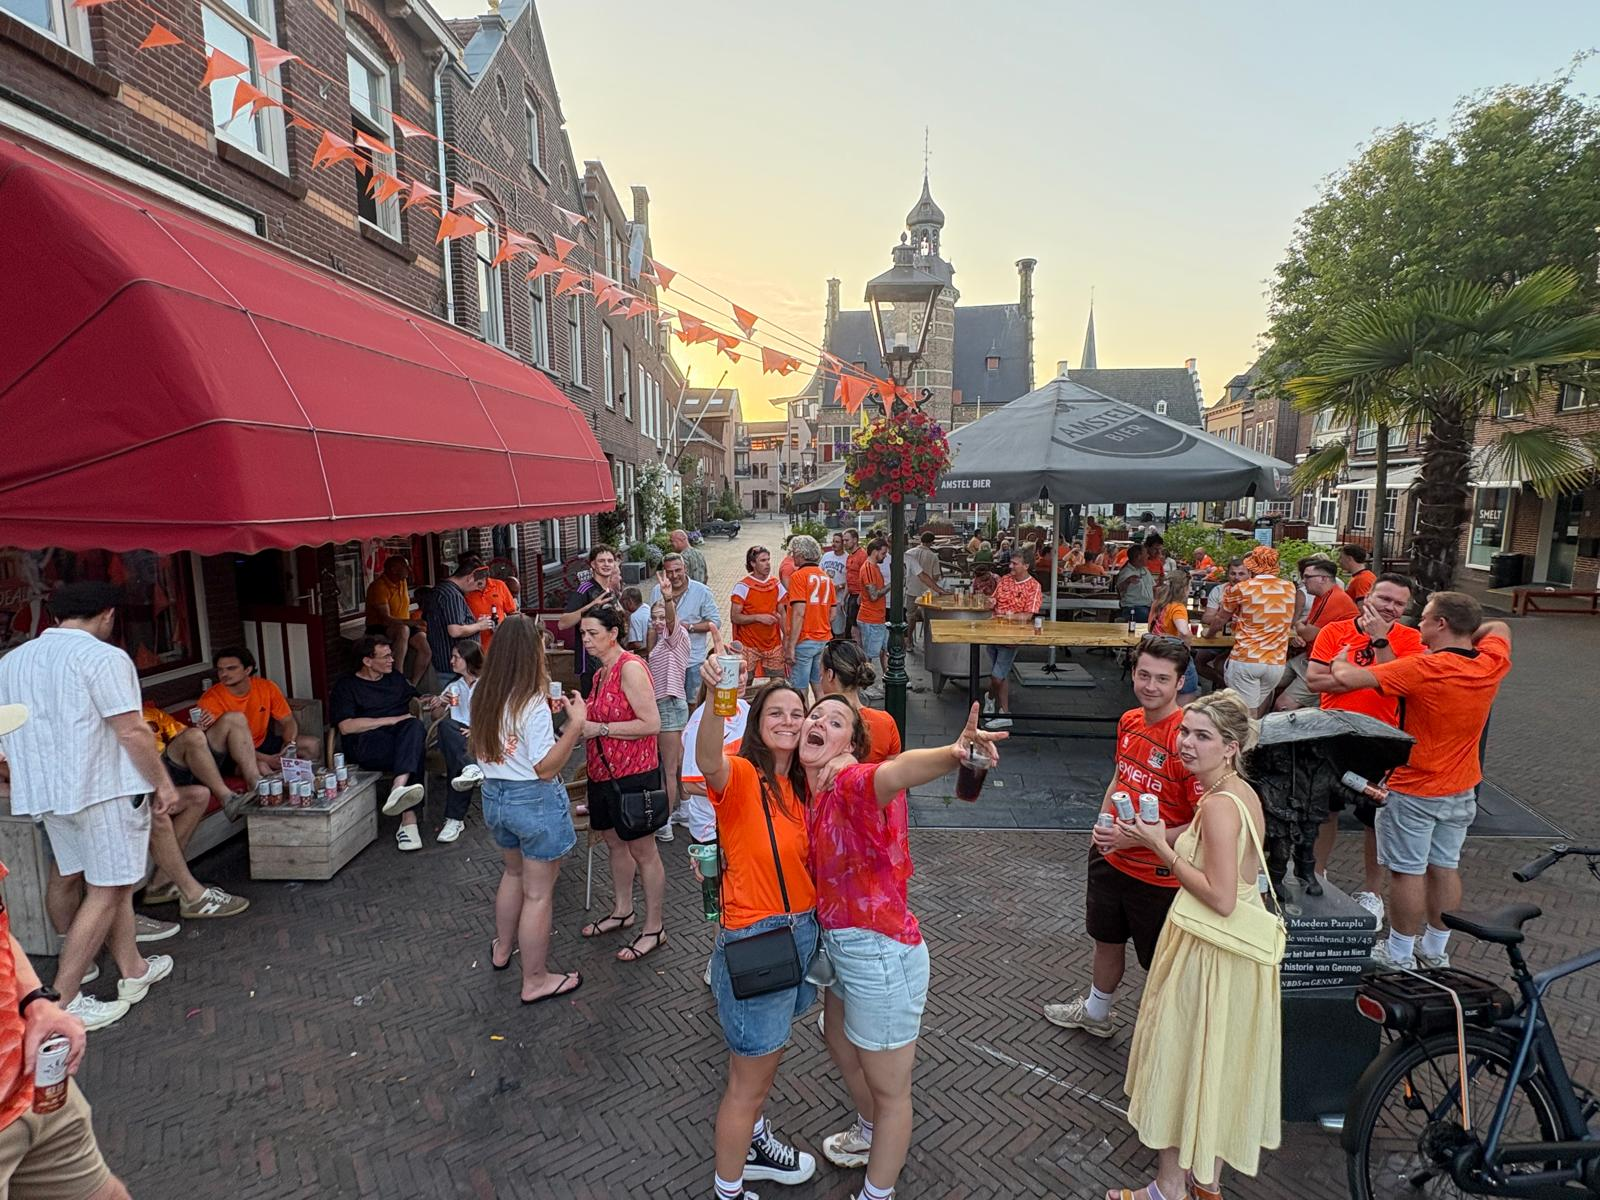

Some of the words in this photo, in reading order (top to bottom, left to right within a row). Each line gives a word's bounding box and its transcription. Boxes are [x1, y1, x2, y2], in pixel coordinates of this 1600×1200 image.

[1059, 407, 1138, 438] AMSTEL
[1104, 424, 1149, 442] BIER
[941, 480, 971, 489] AMSTEL
[972, 479, 991, 489] BIER
[1479, 510, 1502, 520] SMELT
[809, 574, 830, 604] 27
[1291, 919, 1328, 929] Moeders
[1296, 935, 1344, 943] wereldbrand
[1345, 937, 1373, 945] 39/45
[1303, 950, 1316, 958] land
[1327, 949, 1342, 957] Maas
[1284, 963, 1314, 971] historie
[1331, 963, 1362, 973] Gennep
[1310, 978, 1344, 986] GENNEP
